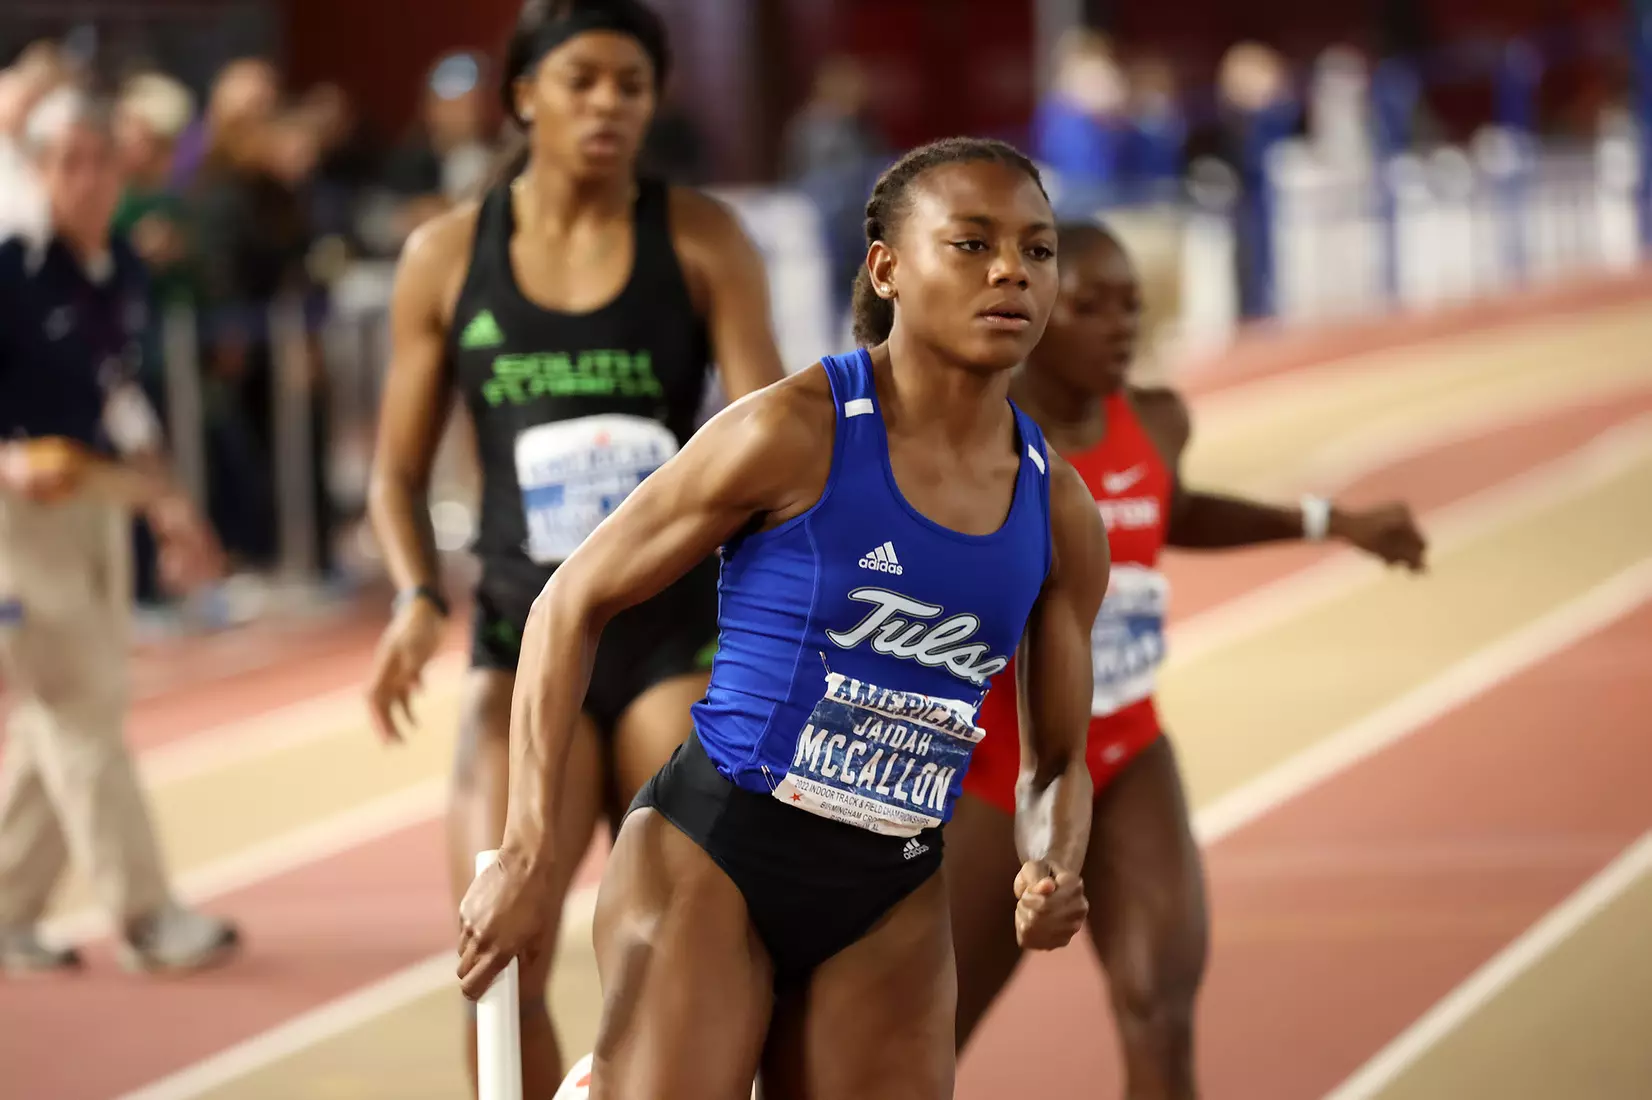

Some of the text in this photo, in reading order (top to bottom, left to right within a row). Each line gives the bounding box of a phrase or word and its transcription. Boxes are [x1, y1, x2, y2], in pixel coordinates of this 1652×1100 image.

[858, 558, 903, 575] adidas
[852, 716, 933, 756] JAIDAH
[793, 723, 957, 811] MCCALLON
[794, 778, 810, 792] 2022
[809, 783, 836, 800] INDOOR
[836, 792, 859, 808] TRACK
[864, 800, 882, 816] FIELD
[820, 801, 863, 819] BIRMINGHAM
